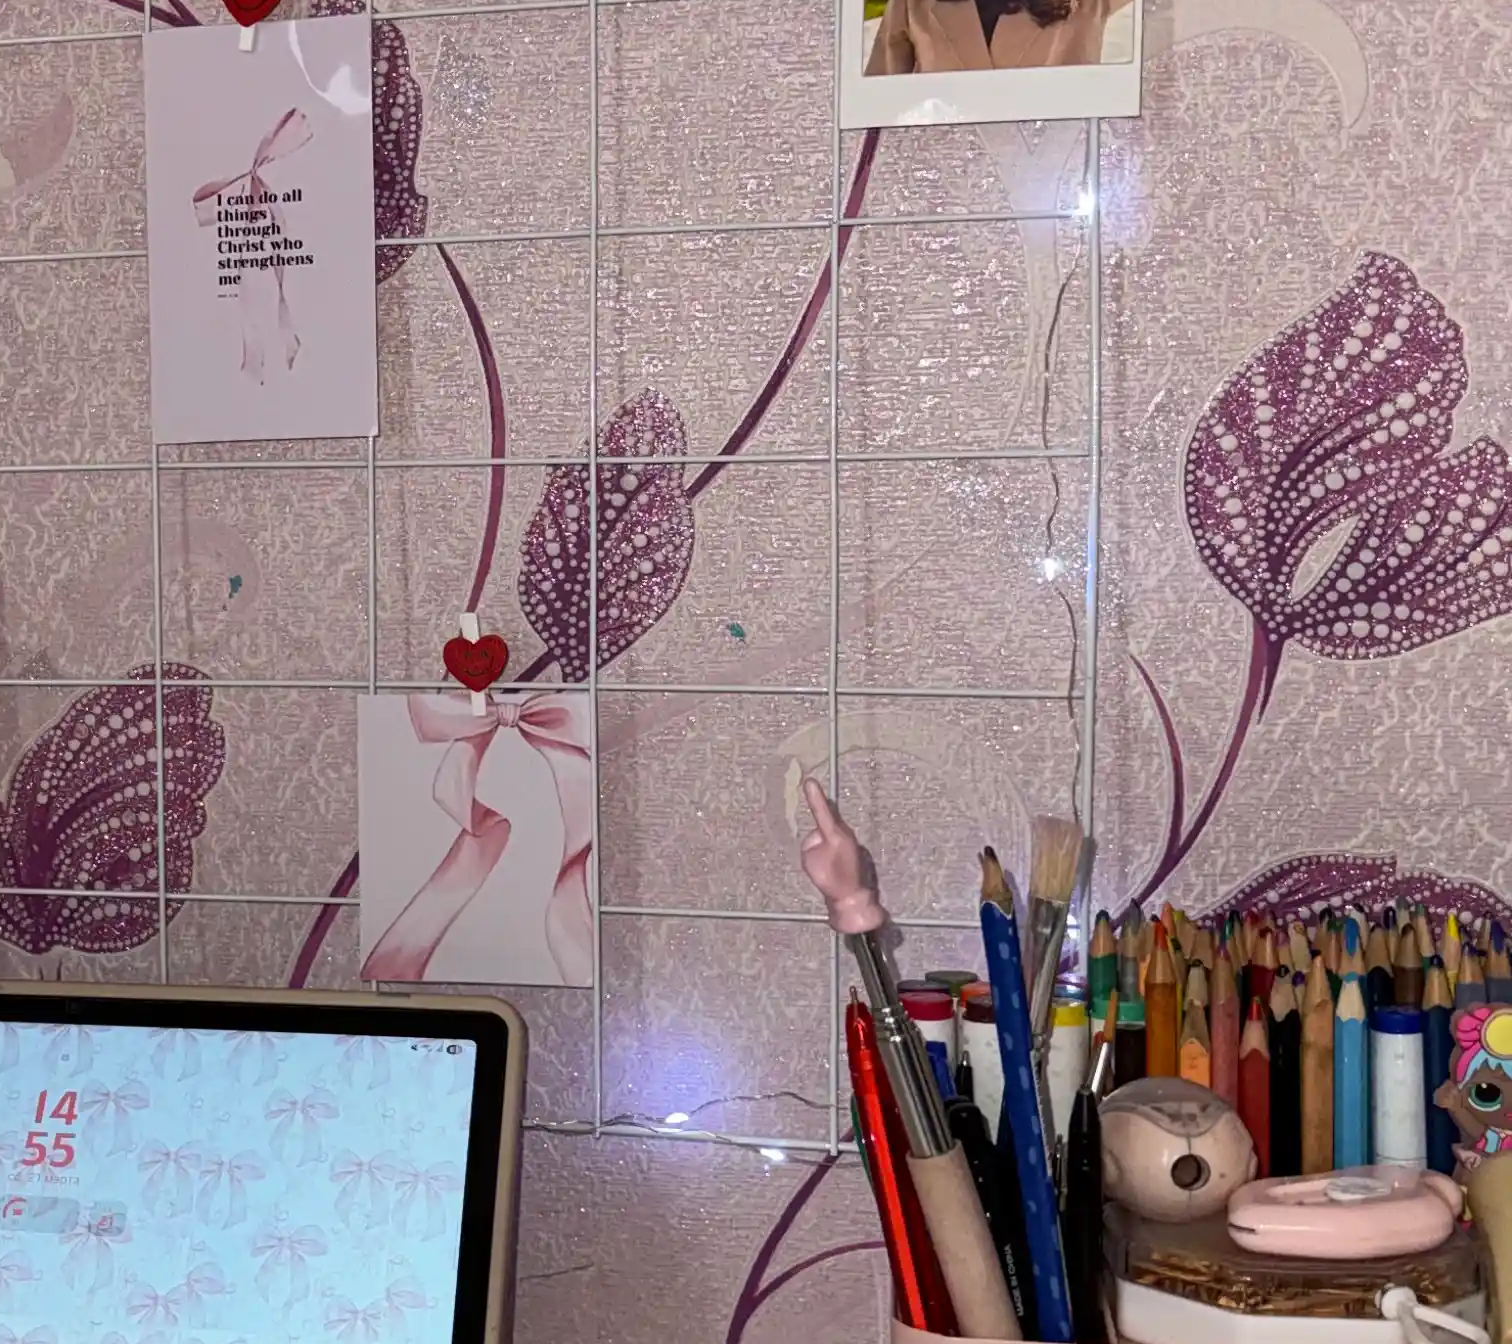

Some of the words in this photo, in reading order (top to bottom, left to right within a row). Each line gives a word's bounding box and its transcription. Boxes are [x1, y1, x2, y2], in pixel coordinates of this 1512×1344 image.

[218, 194, 222, 206] I
[227, 195, 254, 206] can
[259, 191, 278, 204] do
[282, 189, 302, 202] all
[217, 209, 267, 223] things
[217, 223, 281, 239] through
[217, 239, 266, 254] Christ
[270, 238, 303, 250] who
[217, 254, 314, 271] strengthens
[219, 275, 241, 286] me
[34, 1089, 78, 1126] 14
[22, 1131, 76, 1168] 55
